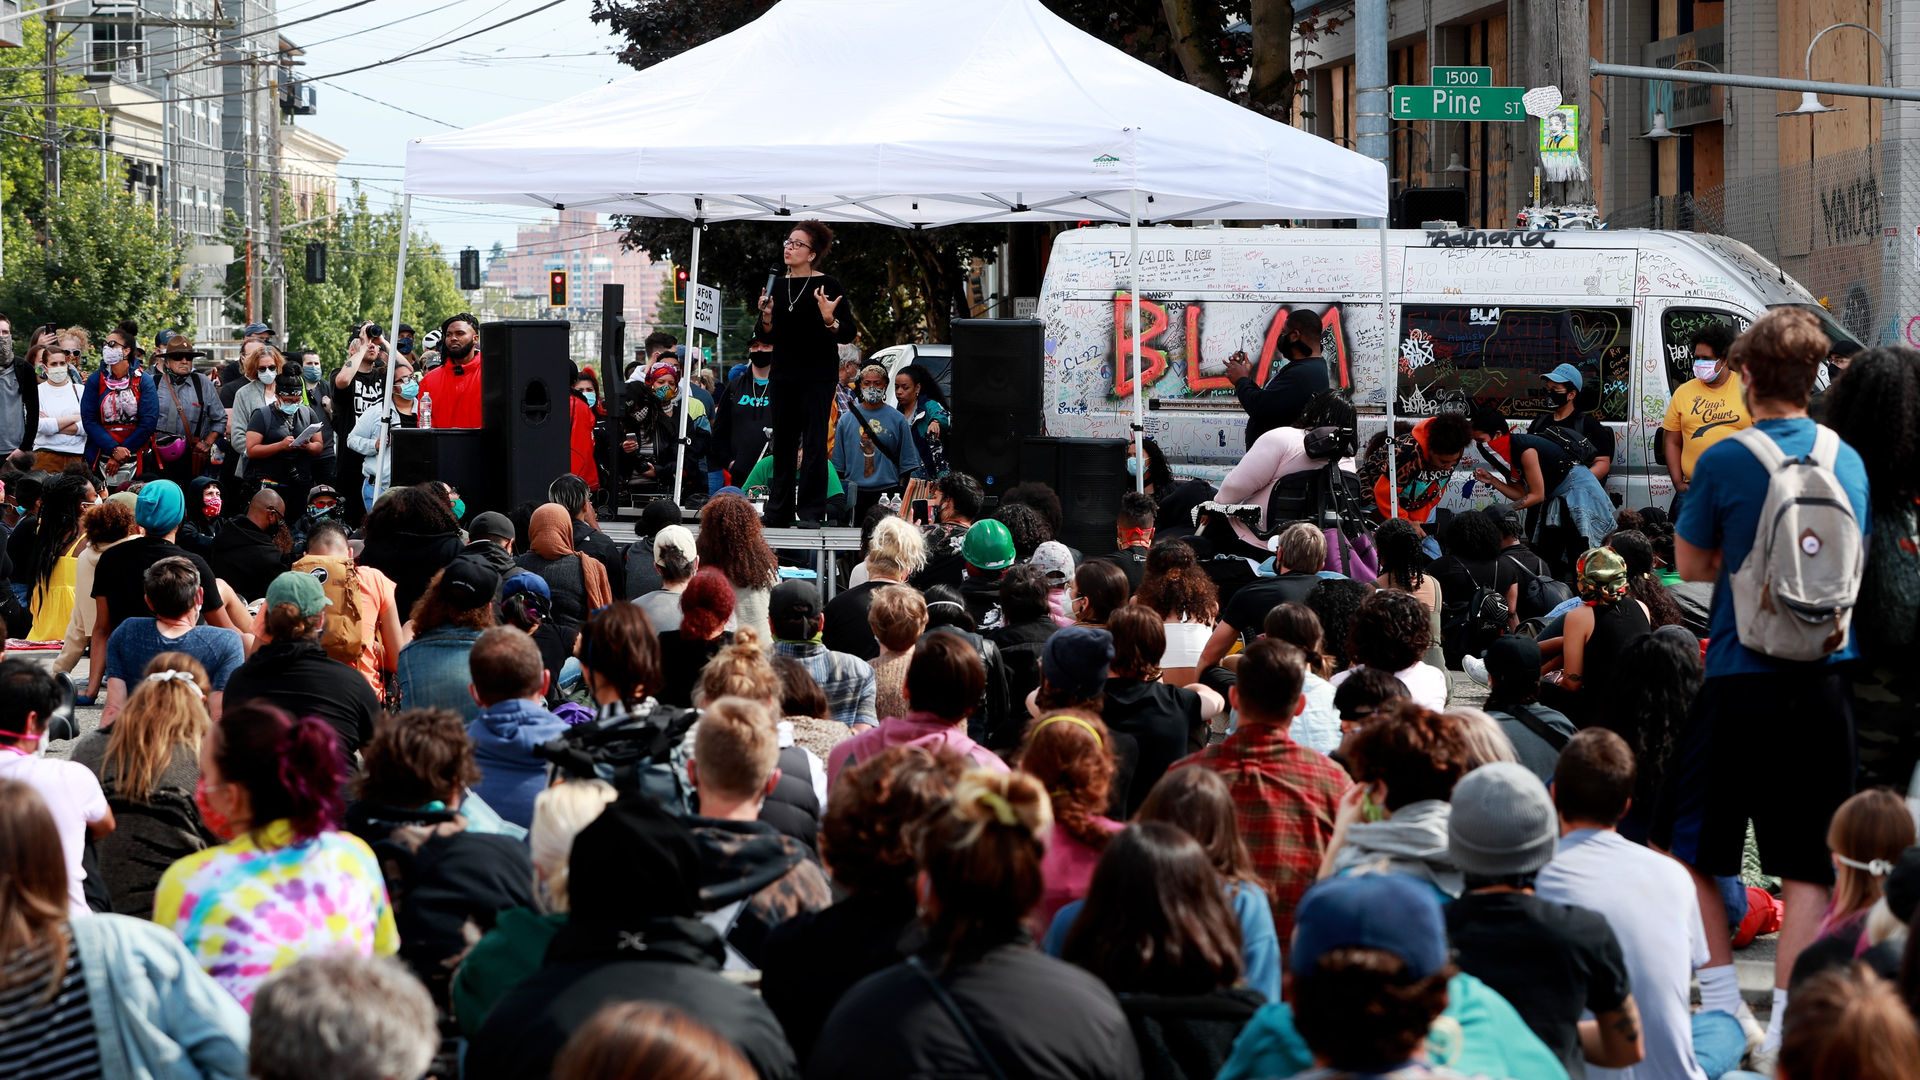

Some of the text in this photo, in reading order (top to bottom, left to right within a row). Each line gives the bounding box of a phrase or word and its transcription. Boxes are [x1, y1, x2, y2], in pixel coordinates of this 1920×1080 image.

[1446, 72, 1478, 85] 1500
[1401, 97, 1411, 113] E
[1433, 90, 1481, 115] Pine
[1504, 102, 1520, 115] ST
[1185, 249, 1211, 262] RICE
[1302, 256, 1331, 267] Black
[1416, 261, 1438, 277] TO
[1447, 259, 1518, 277] PROTECT
[1416, 275, 1584, 292] AND SERVE CAPITAL
[695, 299, 713, 313] LOYD
[1470, 307, 1500, 321] BLM
[1671, 313, 1710, 329] Check
[1113, 291, 1350, 397] BLM
[1448, 330, 1486, 342] Abolish
[1461, 341, 1481, 352] ICE
[355, 379, 383, 399] BLAC
[1690, 398, 1726, 416] King's
[1702, 407, 1736, 424] Court
